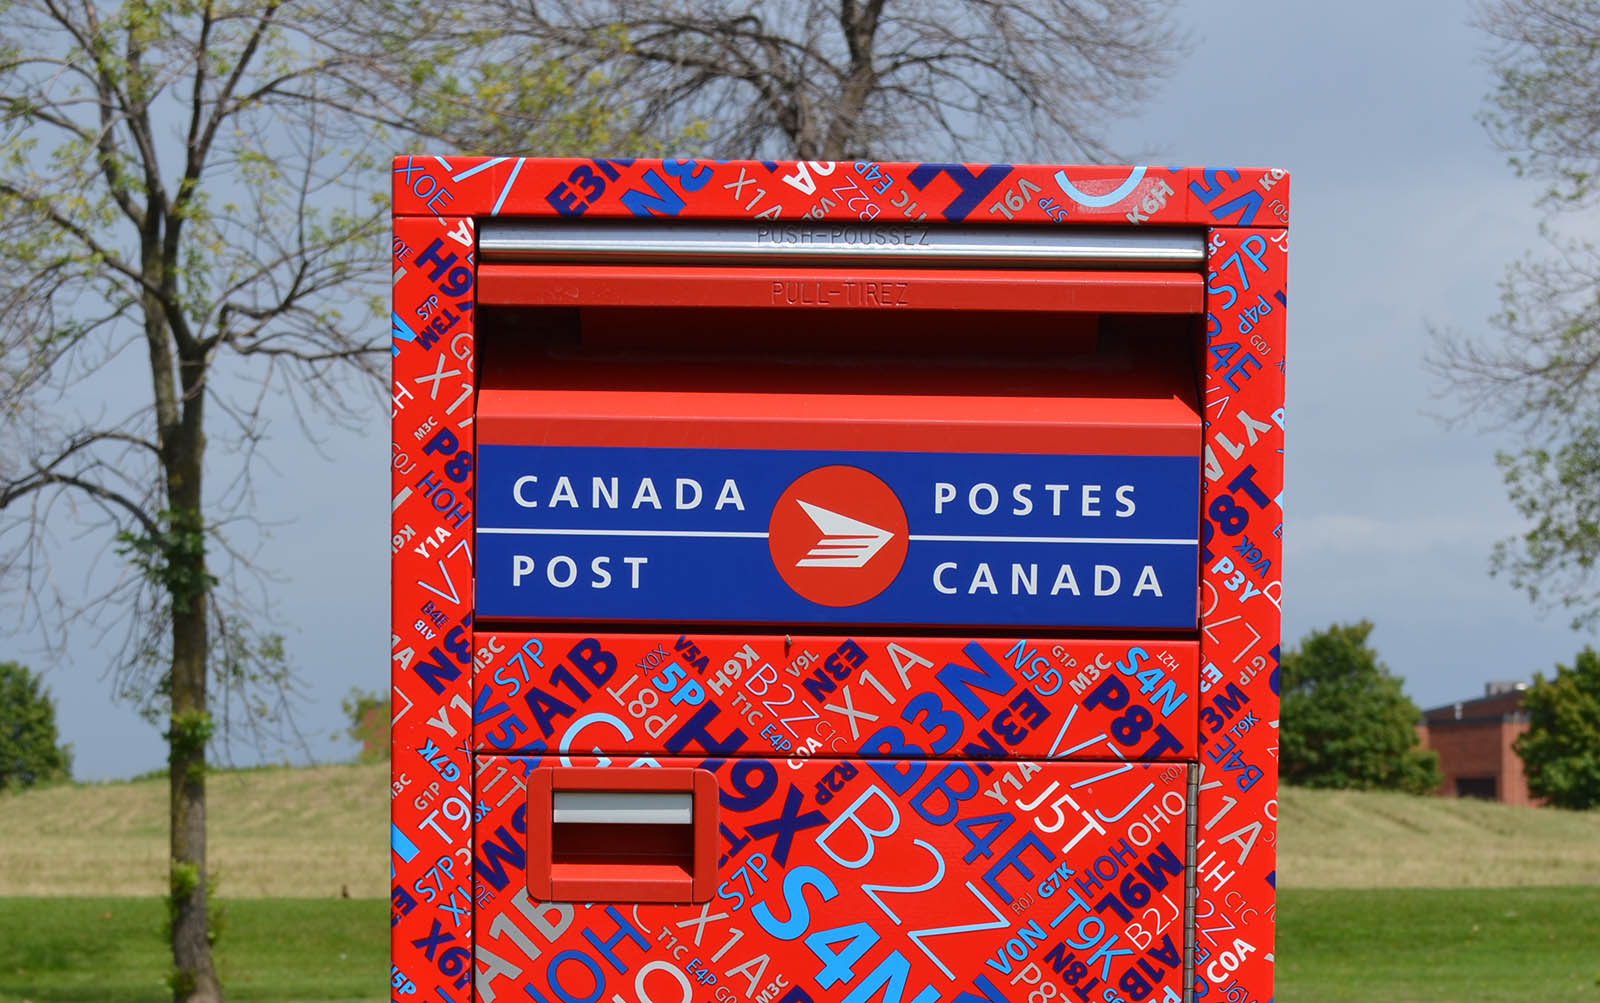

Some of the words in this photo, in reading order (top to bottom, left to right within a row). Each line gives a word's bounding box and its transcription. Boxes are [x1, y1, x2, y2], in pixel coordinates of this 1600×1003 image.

[1126, 178, 1175, 225] K6H
[757, 225, 930, 247] PUSH-POUSSEZ
[414, 237, 472, 296] H9
[1208, 234, 1268, 310] S7P
[416, 294, 438, 320] S7P
[771, 280, 909, 306] PULL-TIREZ
[414, 416, 438, 440] M3C
[513, 475, 745, 511] CANADA
[935, 482, 1136, 517] POSTES
[414, 526, 451, 558] Y1A
[512, 555, 648, 588] POST
[933, 562, 1163, 597] CANADA
[1211, 556, 1261, 603] P3Y
[421, 601, 449, 630] B4E
[494, 638, 544, 696] S7P
[675, 635, 709, 674] V5A
[785, 649, 819, 677] V9L
[1052, 645, 1077, 668] G1P
[1069, 652, 1112, 696] M3C
[524, 638, 618, 739] A1B
[745, 663, 819, 739] B2Z
[824, 642, 935, 741] X1A
[1115, 646, 1188, 718] S4N
[731, 691, 763, 726] T1C
[857, 640, 1017, 796] B3N
[1082, 673, 1184, 768] P8T
[1229, 710, 1260, 738] T9K
[760, 723, 792, 751] E4P
[414, 782, 440, 810] G1P
[984, 762, 1042, 805] Y1A
[909, 761, 1056, 905] B4E
[1015, 780, 1106, 854] J5T
[414, 857, 454, 902] S7P
[718, 852, 768, 911] S7P
[815, 784, 1011, 981] B2Z
[1038, 860, 1075, 897] G7K
[1050, 888, 1134, 982] T9K
[1125, 894, 1179, 950] B2J
[657, 926, 688, 960] T1C
[676, 901, 771, 999] X1A
[685, 957, 717, 985] E4P
[755, 974, 789, 1003] M3C
